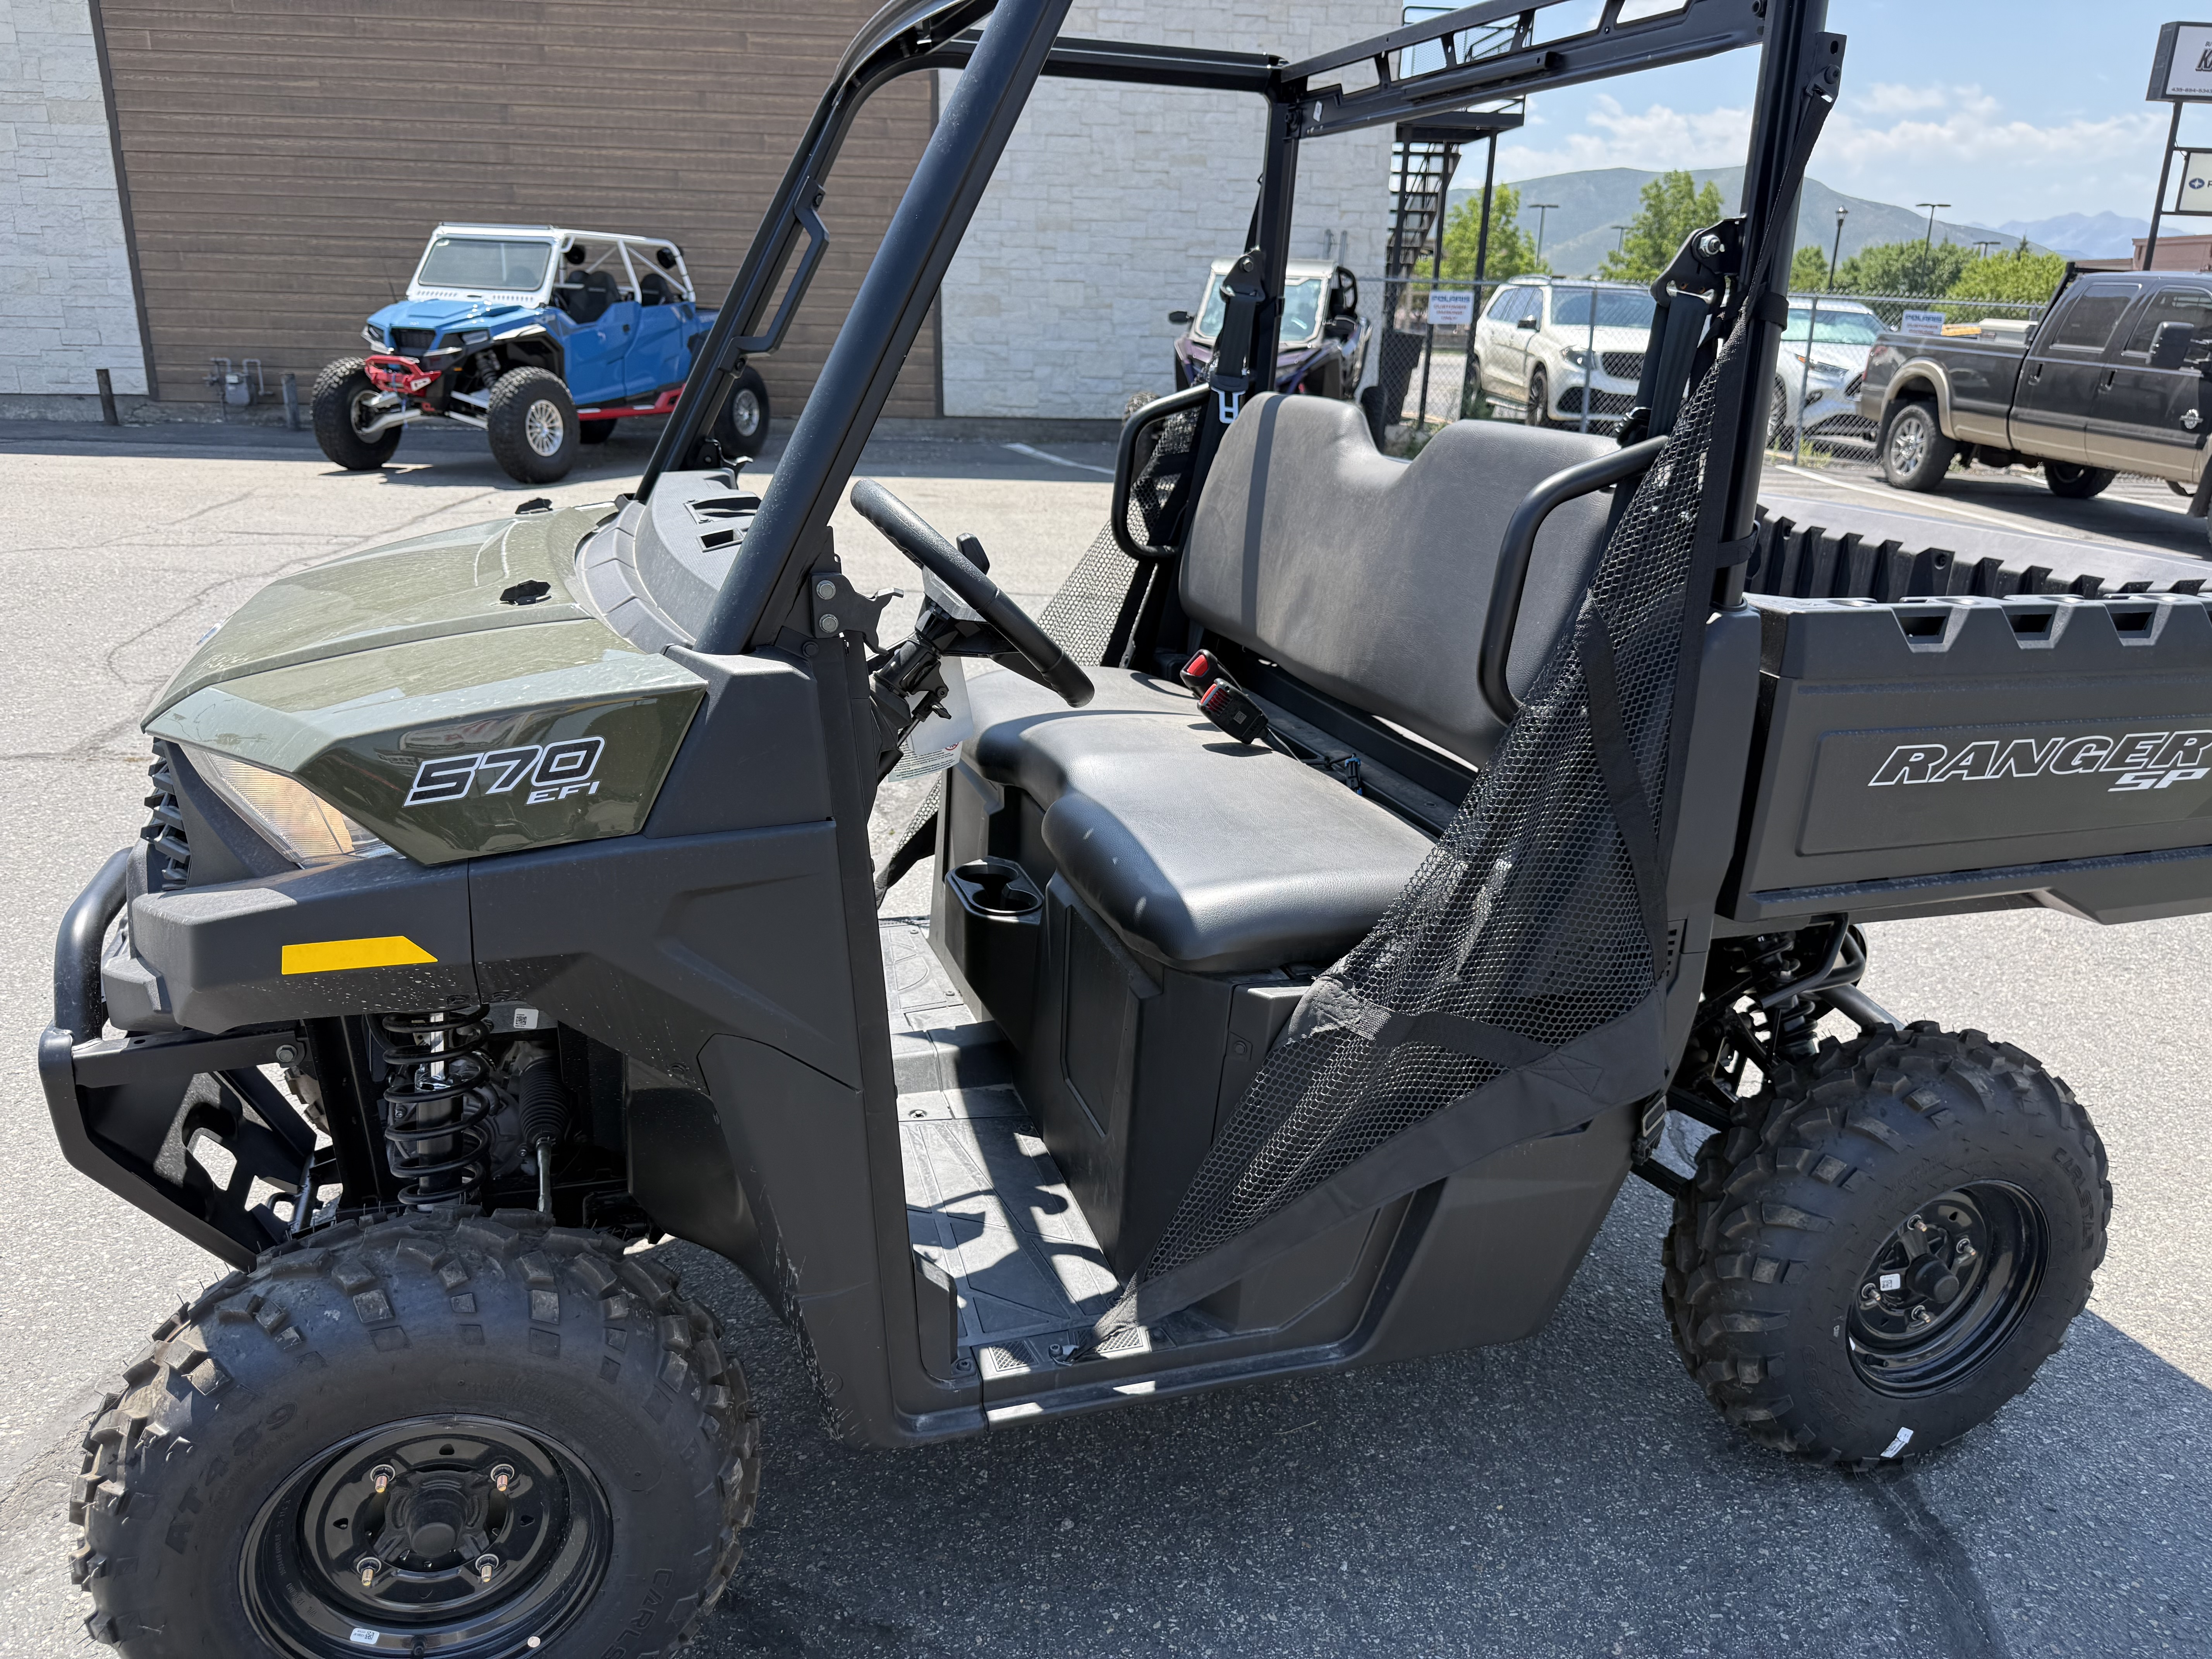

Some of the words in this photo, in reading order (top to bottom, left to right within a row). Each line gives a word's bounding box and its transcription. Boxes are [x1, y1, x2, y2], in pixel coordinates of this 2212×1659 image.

[1905, 314, 1942, 323] POLARIS
[402, 736, 605, 807] 570
[1868, 730, 2212, 787] RANGER
[525, 780, 601, 806] EFI
[2108, 768, 2211, 792] SP
